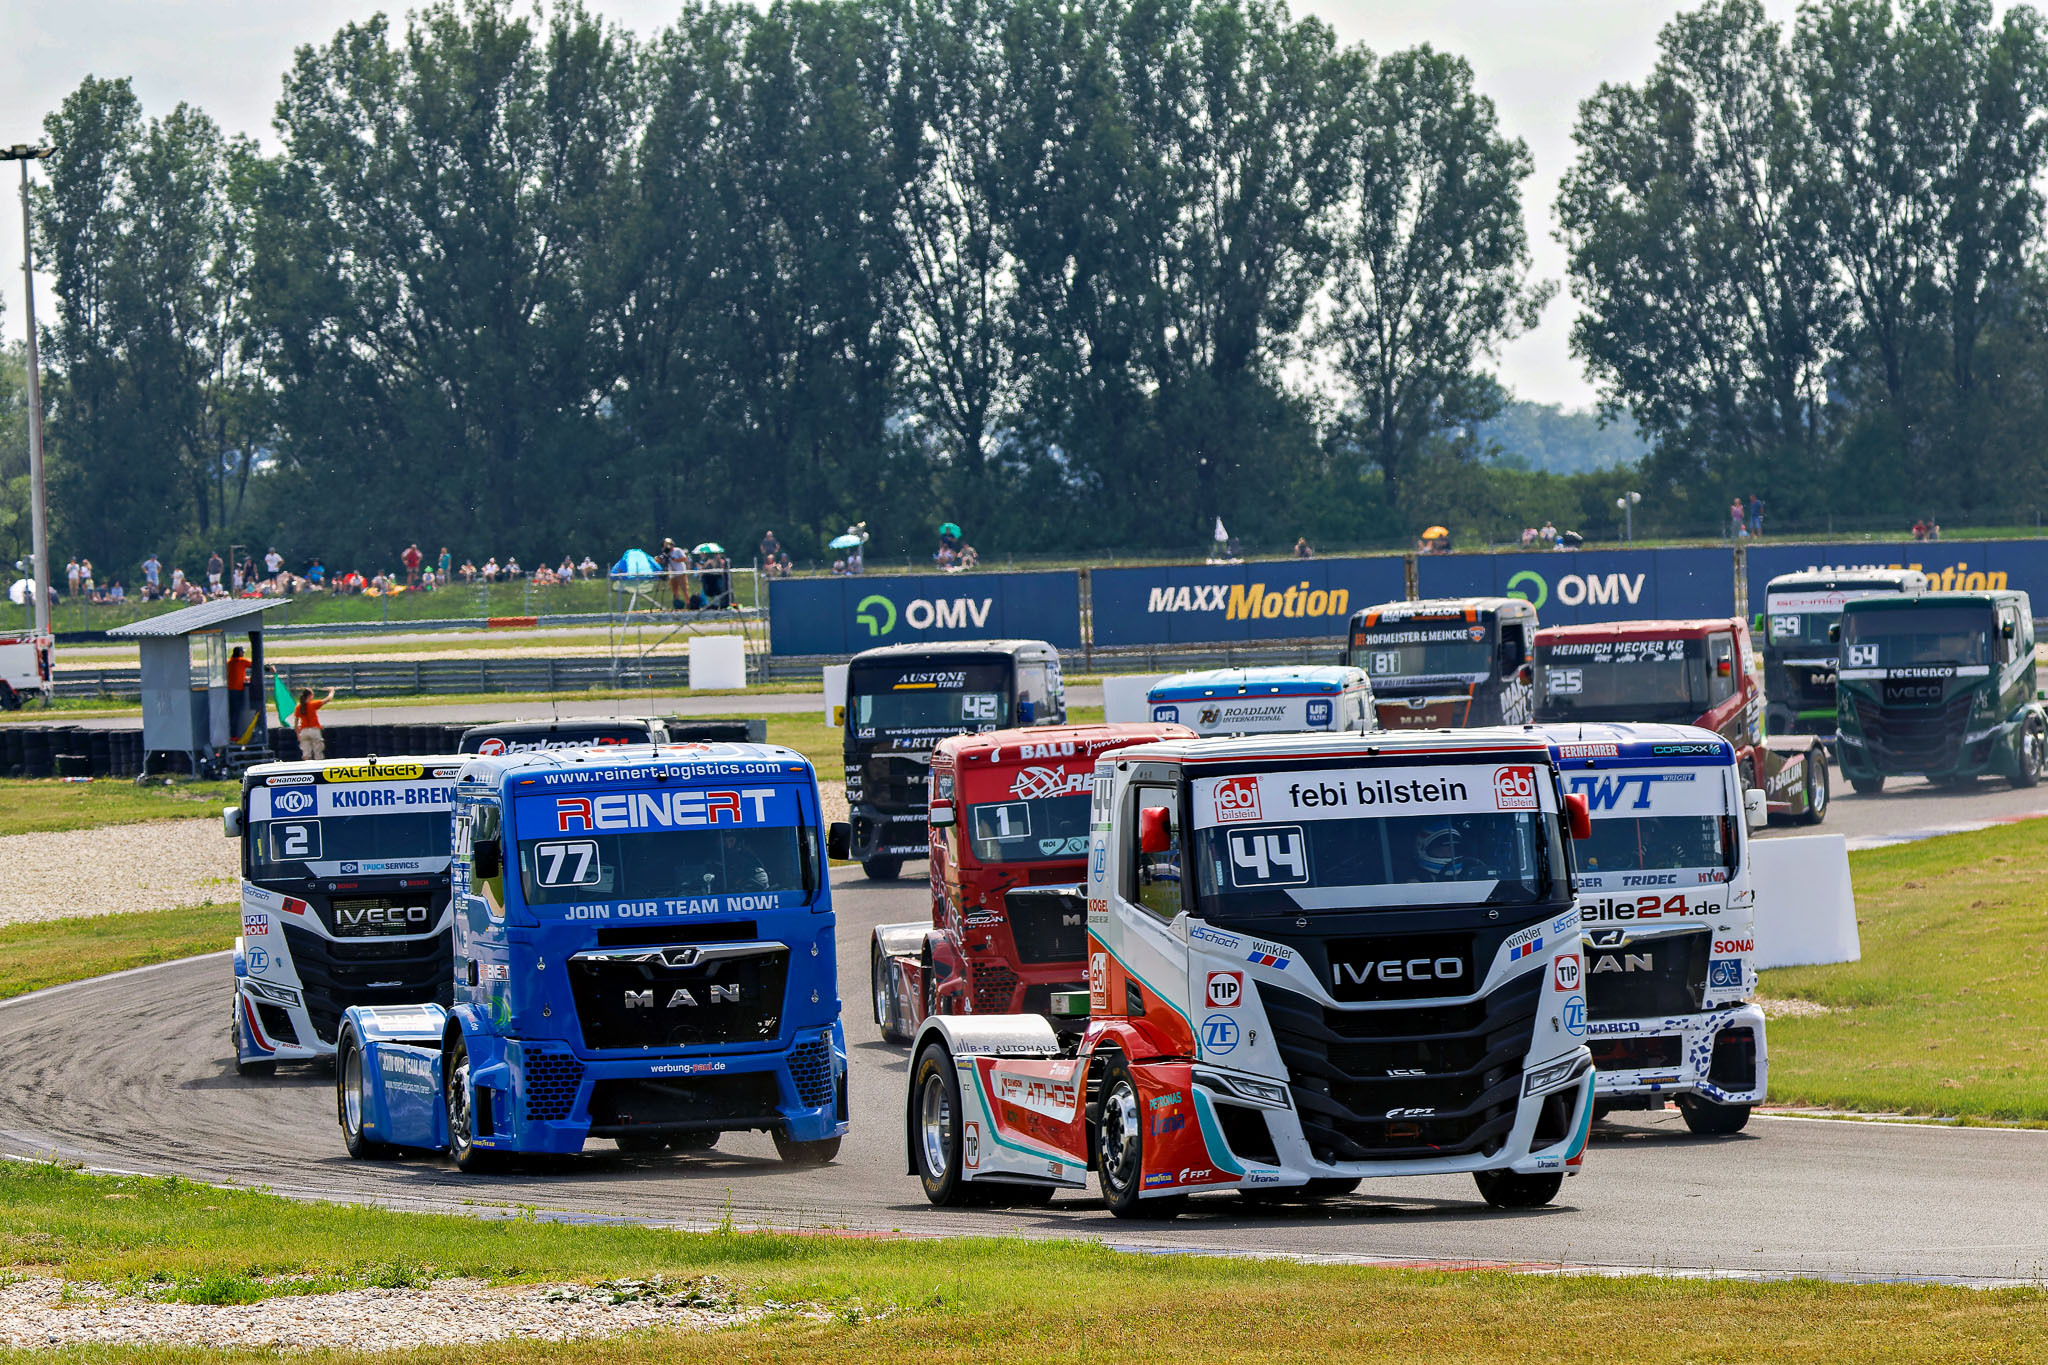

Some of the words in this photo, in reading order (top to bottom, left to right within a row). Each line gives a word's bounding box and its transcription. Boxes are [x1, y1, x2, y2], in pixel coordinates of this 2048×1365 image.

[1888, 562, 2008, 591] otion
[1557, 573, 1645, 606] OMV
[1148, 585, 1228, 613] MAXX
[1226, 581, 1349, 620] Motion
[906, 598, 992, 629] OMV
[1773, 617, 1799, 636] 29
[1366, 631, 1420, 645] HOFMEISTER
[1421, 631, 1427, 641] &
[1429, 629, 1468, 641] MEINCKE
[1552, 643, 1612, 656] HEINRICH
[1614, 641, 1664, 653] HECKER
[1667, 640, 1684, 651] KG
[1376, 654, 1395, 673] 81
[1889, 667, 1953, 679] recuenco
[898, 672, 967, 683] AUSTONE
[1551, 671, 1581, 693] 25
[1887, 687, 1941, 698] IVECO
[964, 697, 997, 718] 42
[1226, 706, 1286, 716] ROADLINK
[1223, 714, 1282, 723] INTERNATIONAL
[1400, 715, 1437, 724] MAN
[859, 728, 875, 737] LCI
[1020, 742, 1075, 759] BALU
[1560, 744, 1618, 758] FERNFAHRER
[1653, 745, 1709, 755] COREXX
[329, 764, 418, 779] PALFINGER
[545, 761, 781, 784] www.reinert-logistics.com
[1495, 768, 1535, 796] febi
[1215, 780, 1258, 809] febi
[1289, 782, 1348, 808] febi
[1357, 778, 1467, 806] bilstein
[1501, 798, 1534, 807] bilstein
[557, 789, 775, 831] REINERT
[1221, 810, 1257, 820] bilstein
[996, 807, 1010, 836] 1
[285, 826, 308, 855] 2
[540, 844, 593, 885] 77
[1232, 834, 1304, 878] 44
[1622, 874, 1678, 887] TRIDEC
[1698, 869, 1726, 883] HYVA
[336, 906, 428, 924] IVECO
[565, 904, 609, 921] JOIN
[618, 902, 658, 918] OUR
[665, 898, 719, 915] TEAM
[728, 895, 779, 912] NOW!
[1506, 927, 1542, 949] winkler
[1253, 941, 1294, 959] winkler
[1333, 957, 1463, 985] IVECO
[1584, 953, 1653, 973] AN
[1559, 965, 1578, 982] TIP
[625, 983, 740, 1009] MAN
[1211, 983, 1237, 999] TIP
[651, 1062, 726, 1074] werbung-paul.de
[1025, 1082, 1075, 1108] ATHOS
[1149, 1091, 1182, 1111] PETRONAS
[967, 1137, 977, 1156] TIP
[1190, 1169, 1212, 1178] FPT
[1251, 1174, 1279, 1183] Urania
